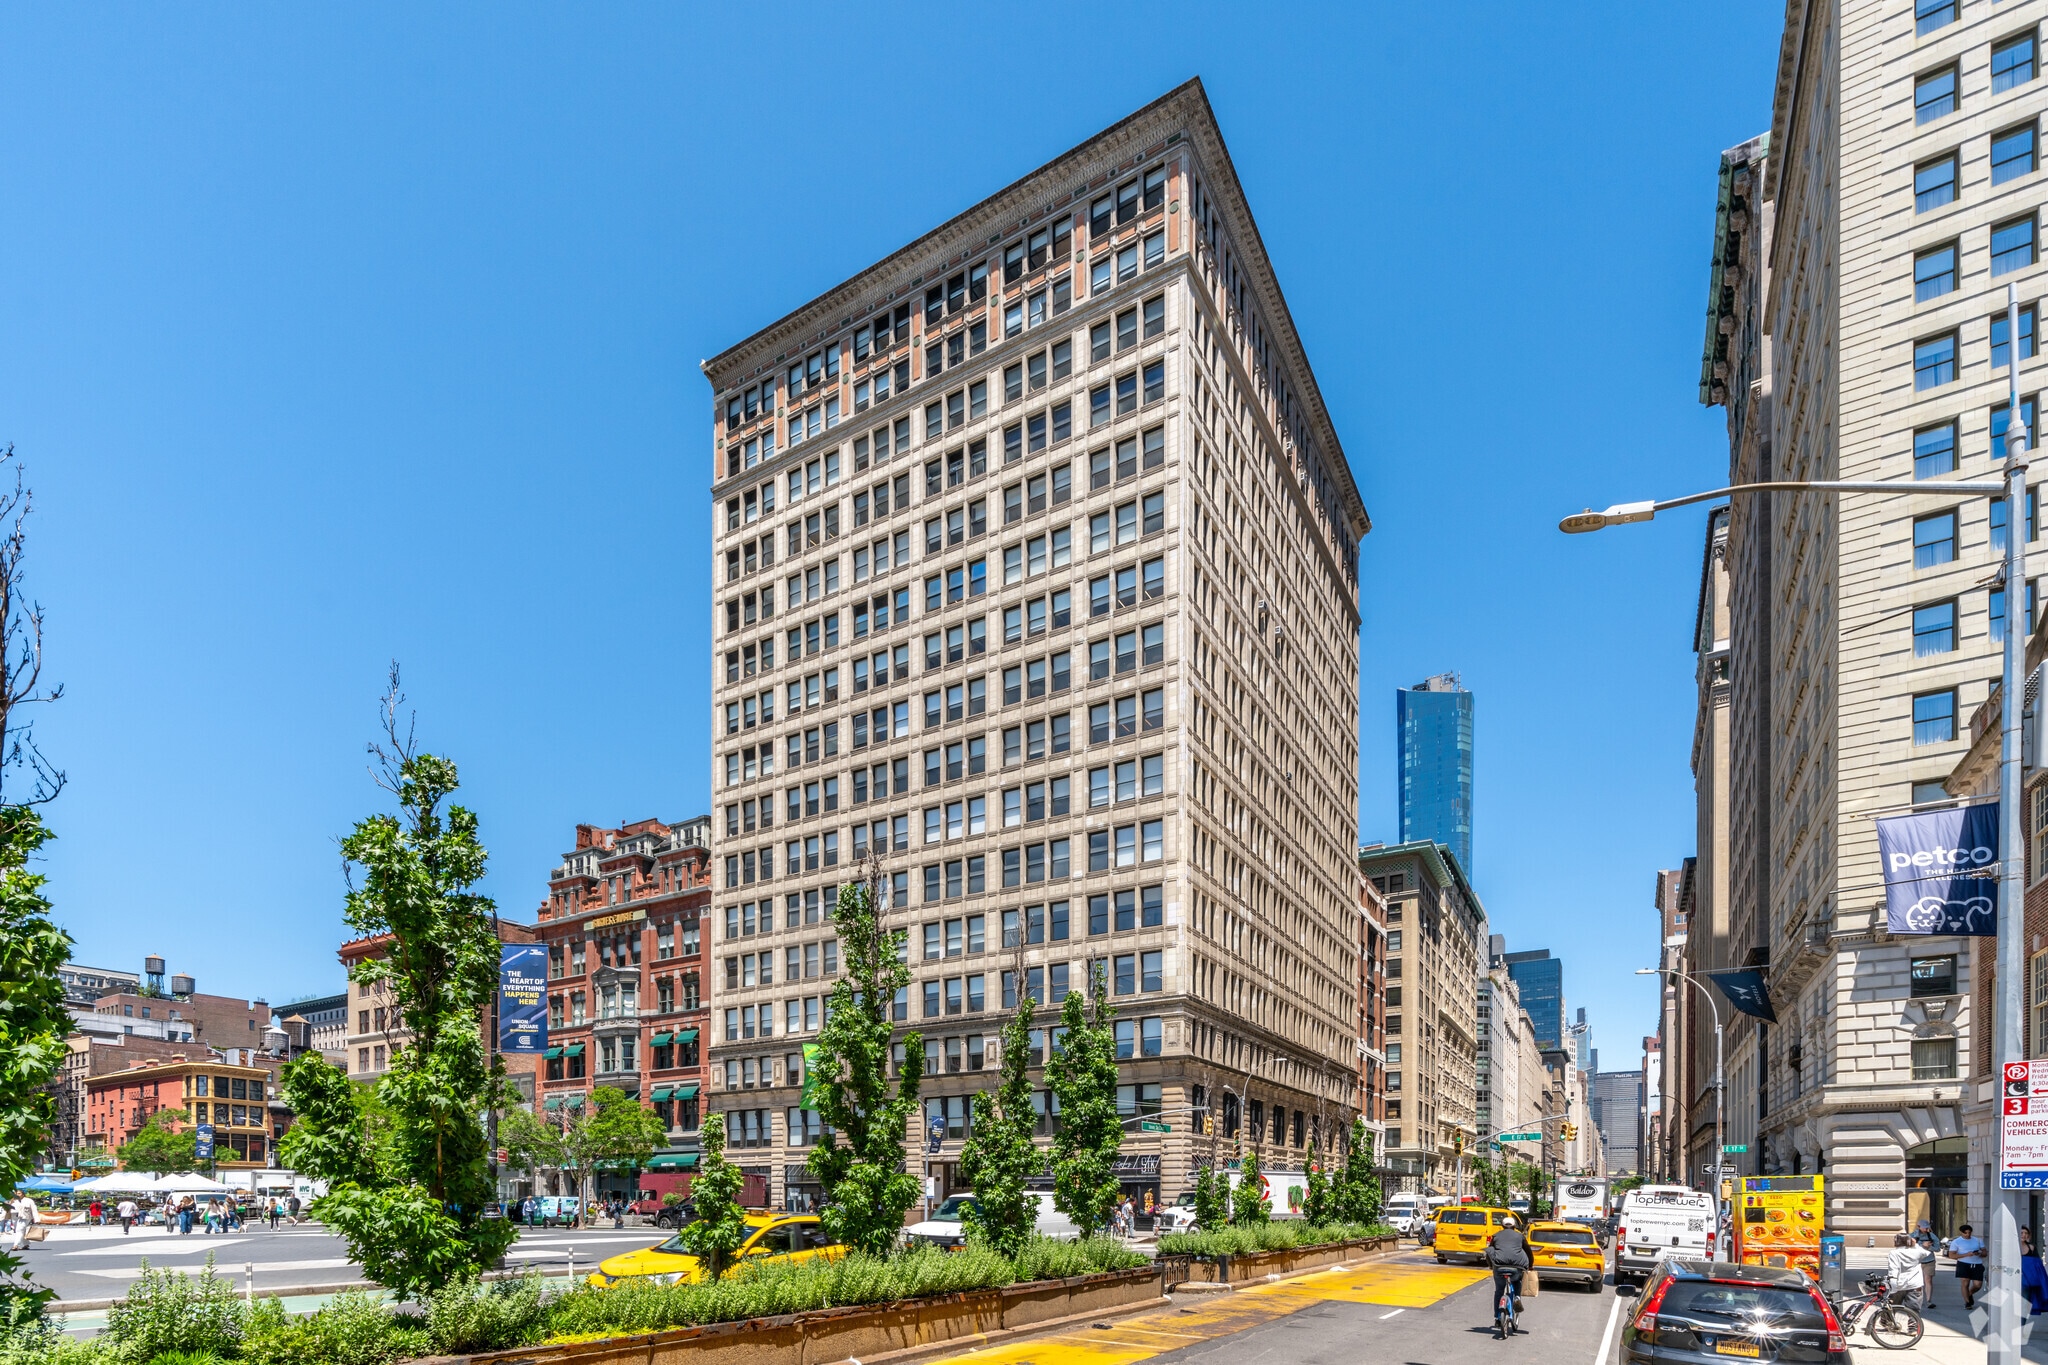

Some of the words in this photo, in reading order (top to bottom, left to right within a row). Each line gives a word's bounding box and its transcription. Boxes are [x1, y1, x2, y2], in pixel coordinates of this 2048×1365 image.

[1890, 846, 1993, 873] petco
[1926, 873, 1977, 881] ELLNES
[509, 977, 533, 985] HEART
[502, 984, 546, 992] EVERYTHING
[505, 991, 540, 999] HAPPENS
[518, 998, 538, 1006] HERE
[2009, 1099, 2023, 1115] 3
[2006, 1120, 2048, 1128] COMMERC
[299, 1185, 310, 1193] NYC
[1570, 1185, 1594, 1195] Baldor
[1633, 1193, 1705, 1208] TopBrewer
[1630, 1218, 1686, 1226] topbrewernyc.com
[1828, 1245, 1837, 1254] P
